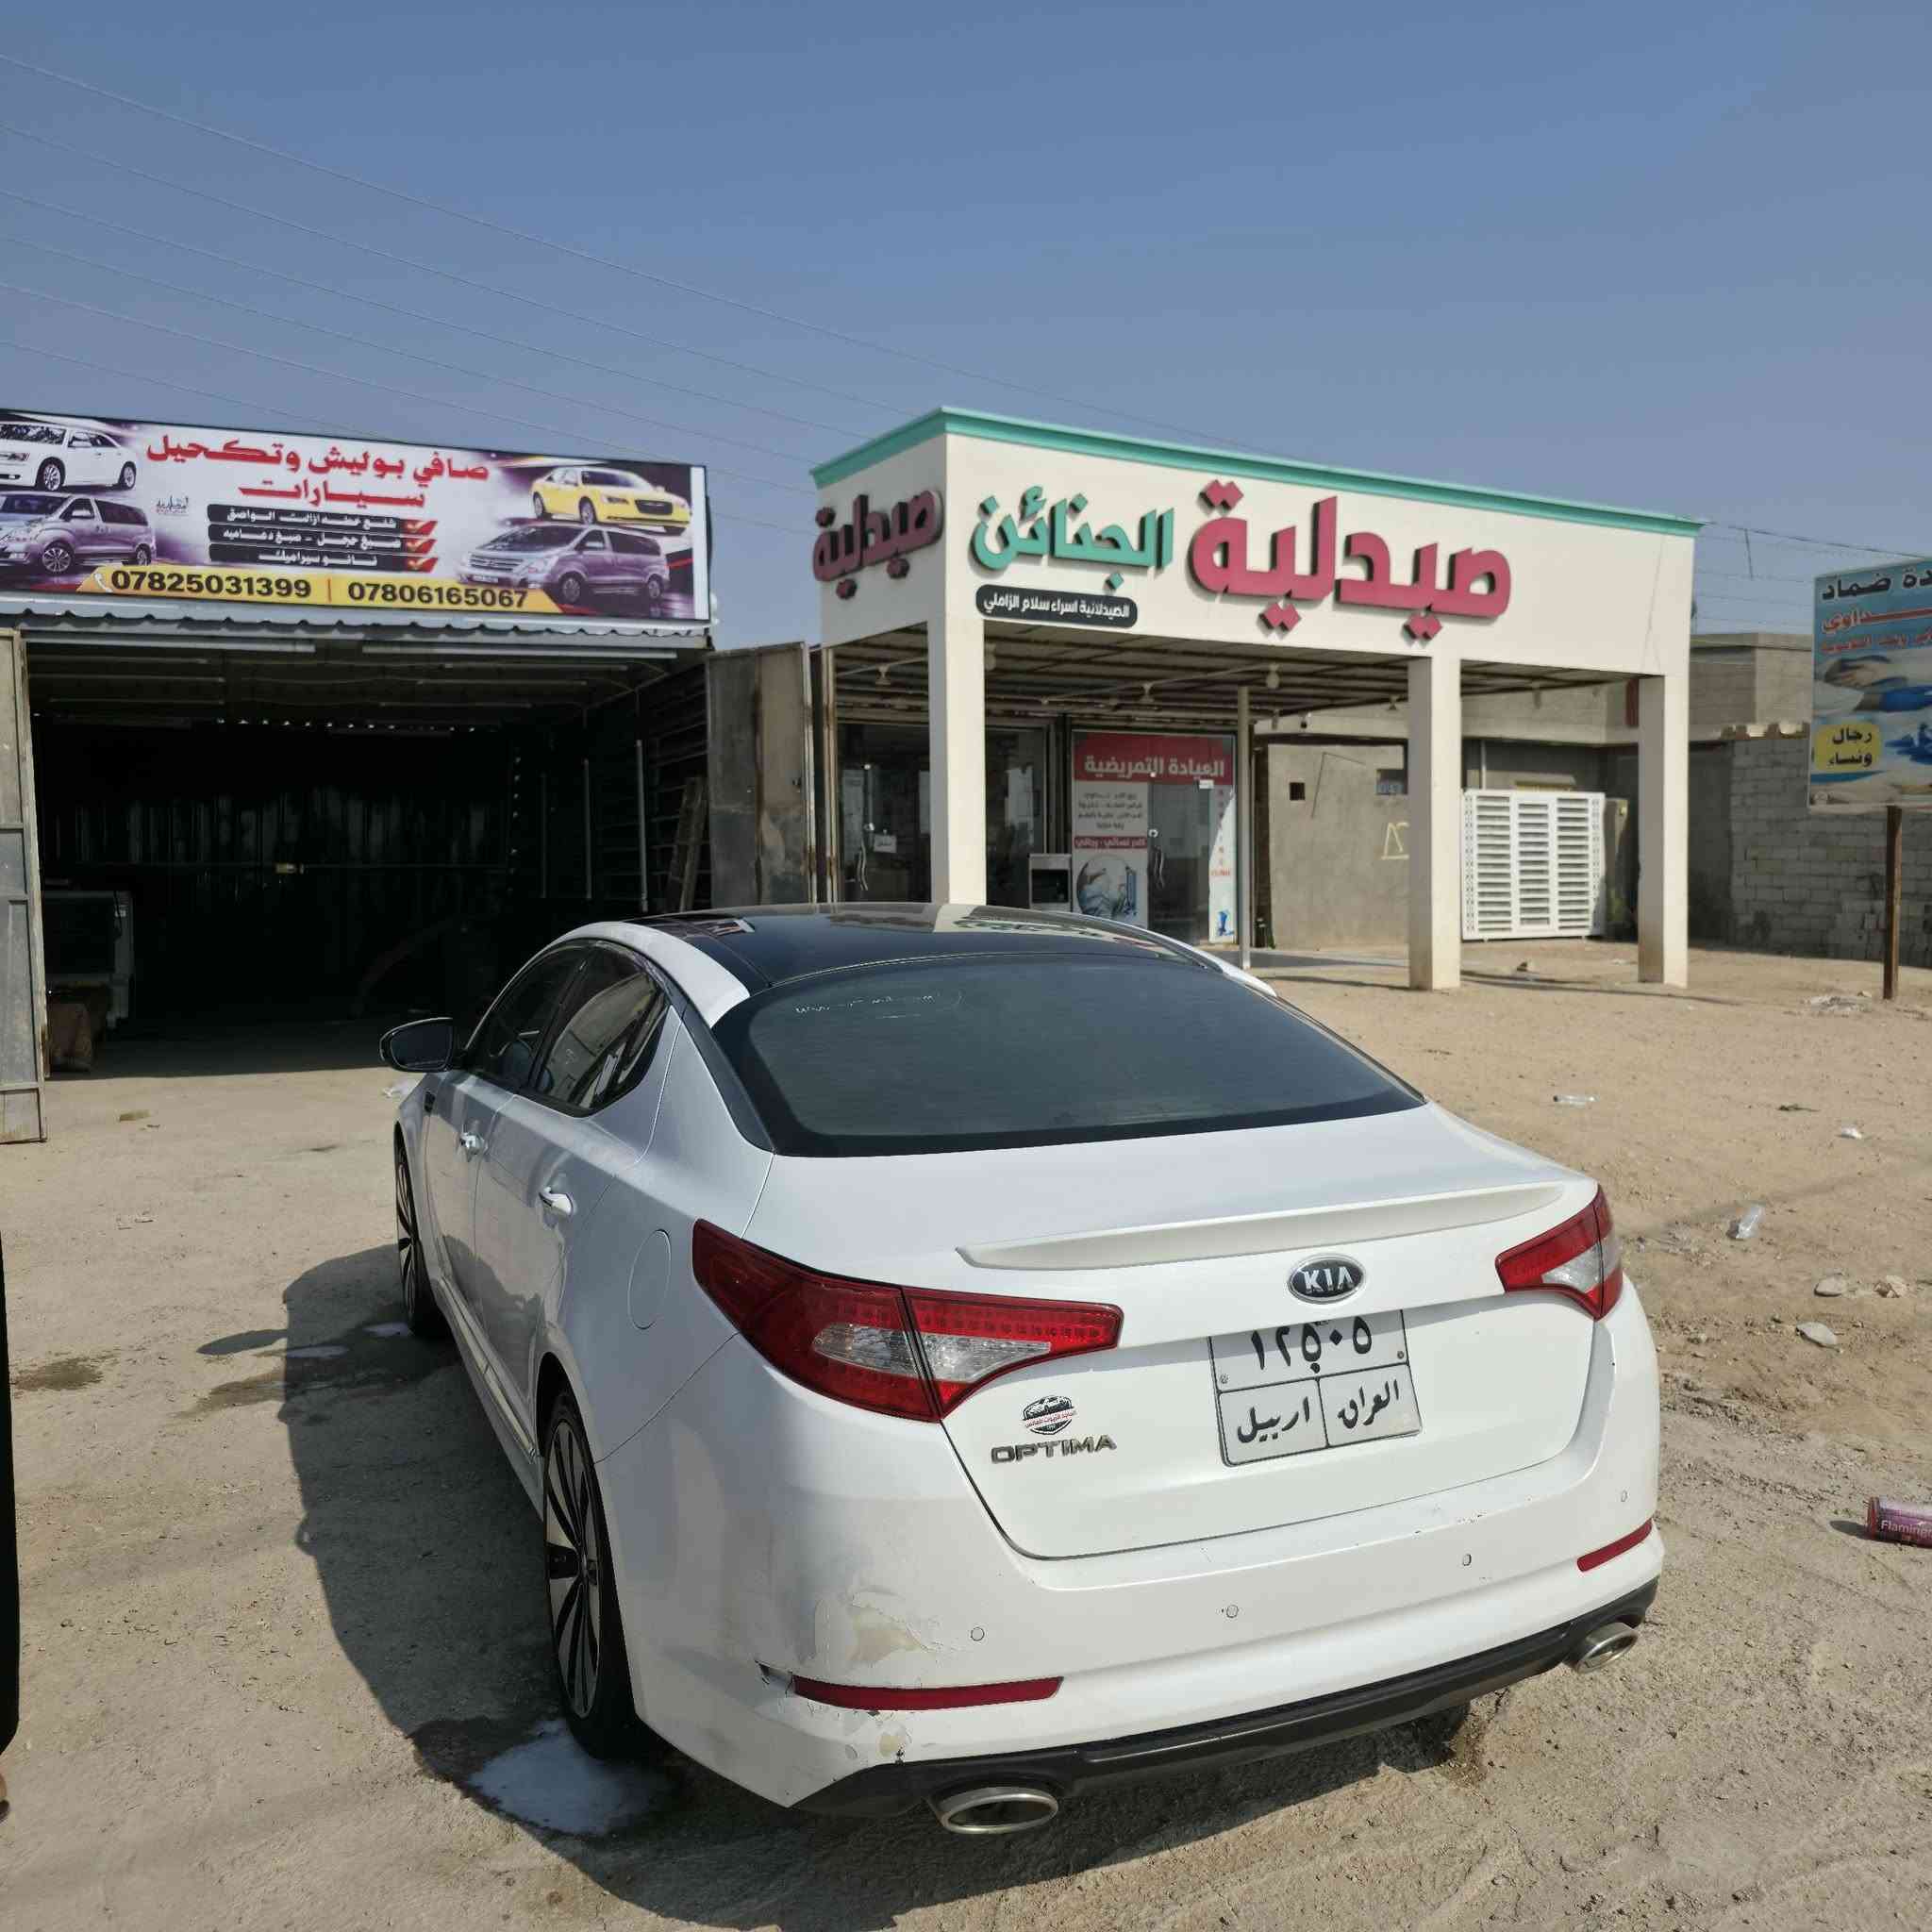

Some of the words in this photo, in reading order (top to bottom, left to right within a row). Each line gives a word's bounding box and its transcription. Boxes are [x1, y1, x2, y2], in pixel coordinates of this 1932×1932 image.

[146, 434, 301, 473] وتكحيل
[308, 446, 405, 479] بوليش
[413, 451, 490, 488] صافي
[813, 490, 942, 600] صيدلية
[971, 485, 1174, 591] الجنائن
[1189, 479, 1511, 641] صيدلية
[110, 570, 312, 599] 07825031399
[348, 581, 528, 608] 07806165067
[1822, 573, 1891, 601] ضماد
[1021, 595, 1050, 612] سلام
[1051, 598, 1078, 615] اسراء
[1079, 600, 1130, 621] الصيدلانية
[1832, 728, 1873, 745] رجال
[1085, 755, 1164, 779] التمريضية
[1168, 757, 1224, 780] العيادة
[1828, 750, 1873, 767] ونساء
[1301, 1265, 1355, 1294] KIA
[1337, 1378, 1400, 1430] العراق
[1237, 1396, 1311, 1444] اربيل
[991, 1434, 1118, 1465] OPTIMA
